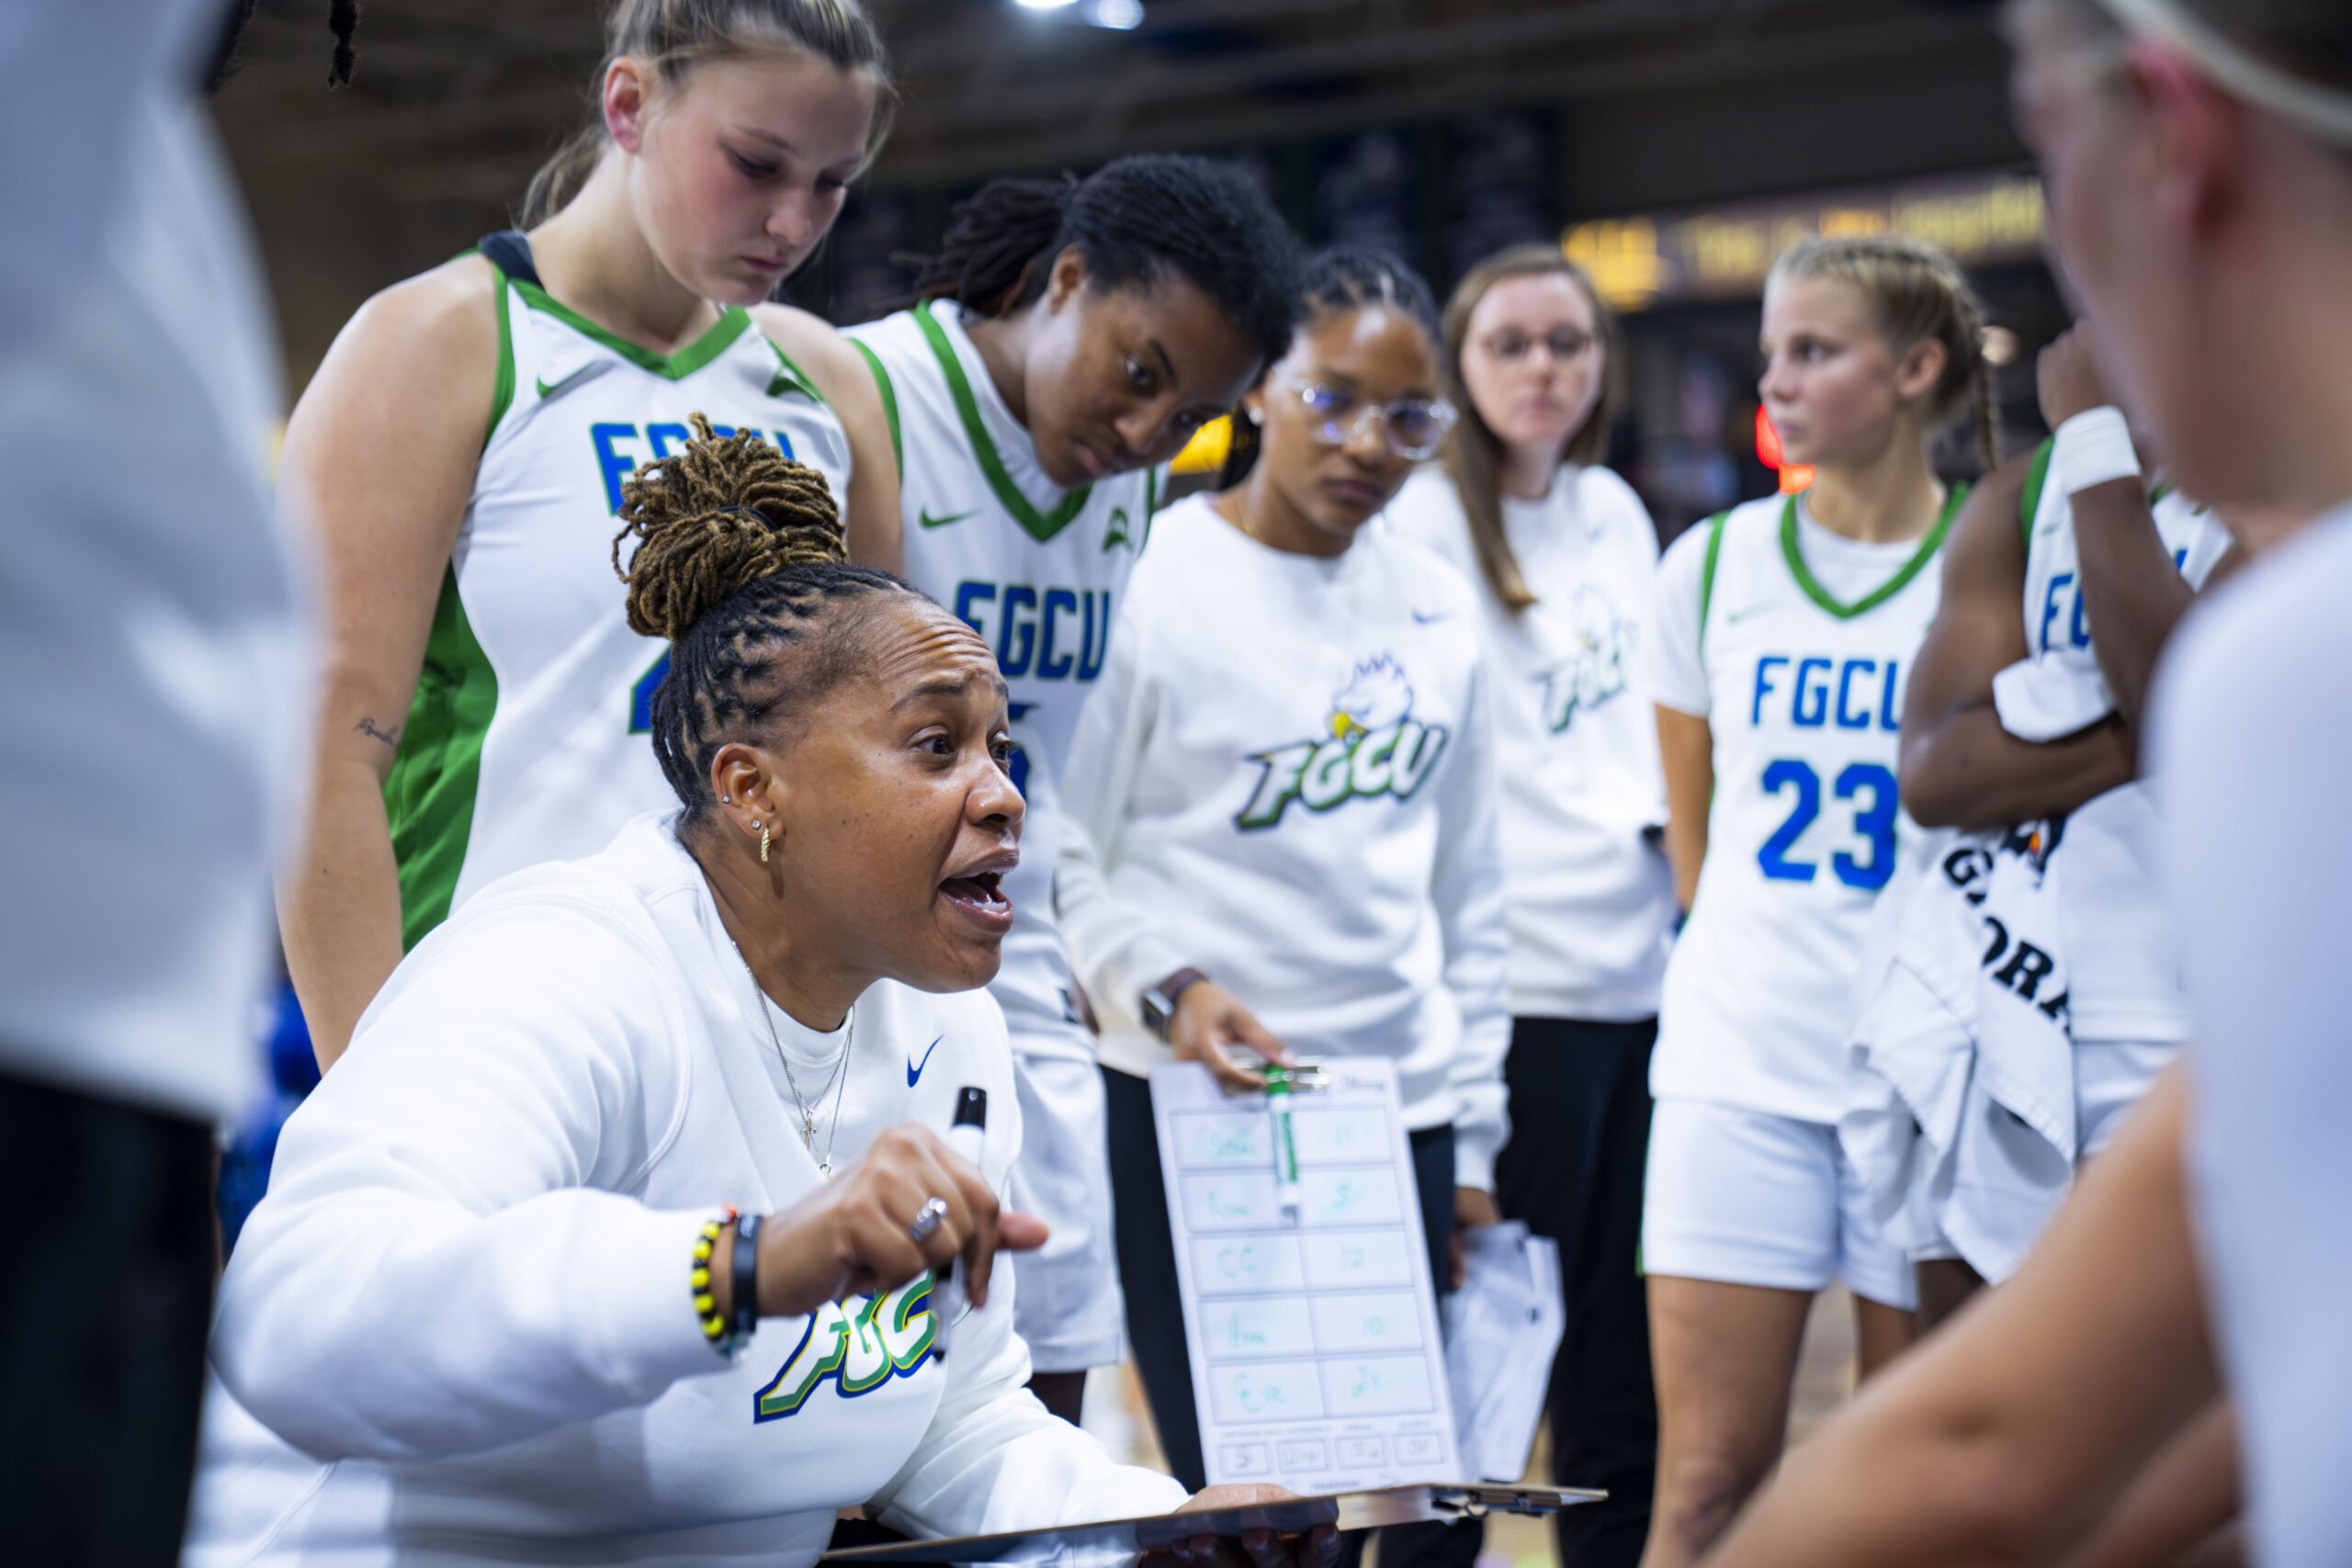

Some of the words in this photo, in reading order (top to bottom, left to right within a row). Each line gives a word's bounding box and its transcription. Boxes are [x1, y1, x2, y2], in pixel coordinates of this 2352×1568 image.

[1233, 719, 1450, 834] FGCU
[1758, 760, 1900, 891] 23
[753, 1268, 943, 1424] FGC
